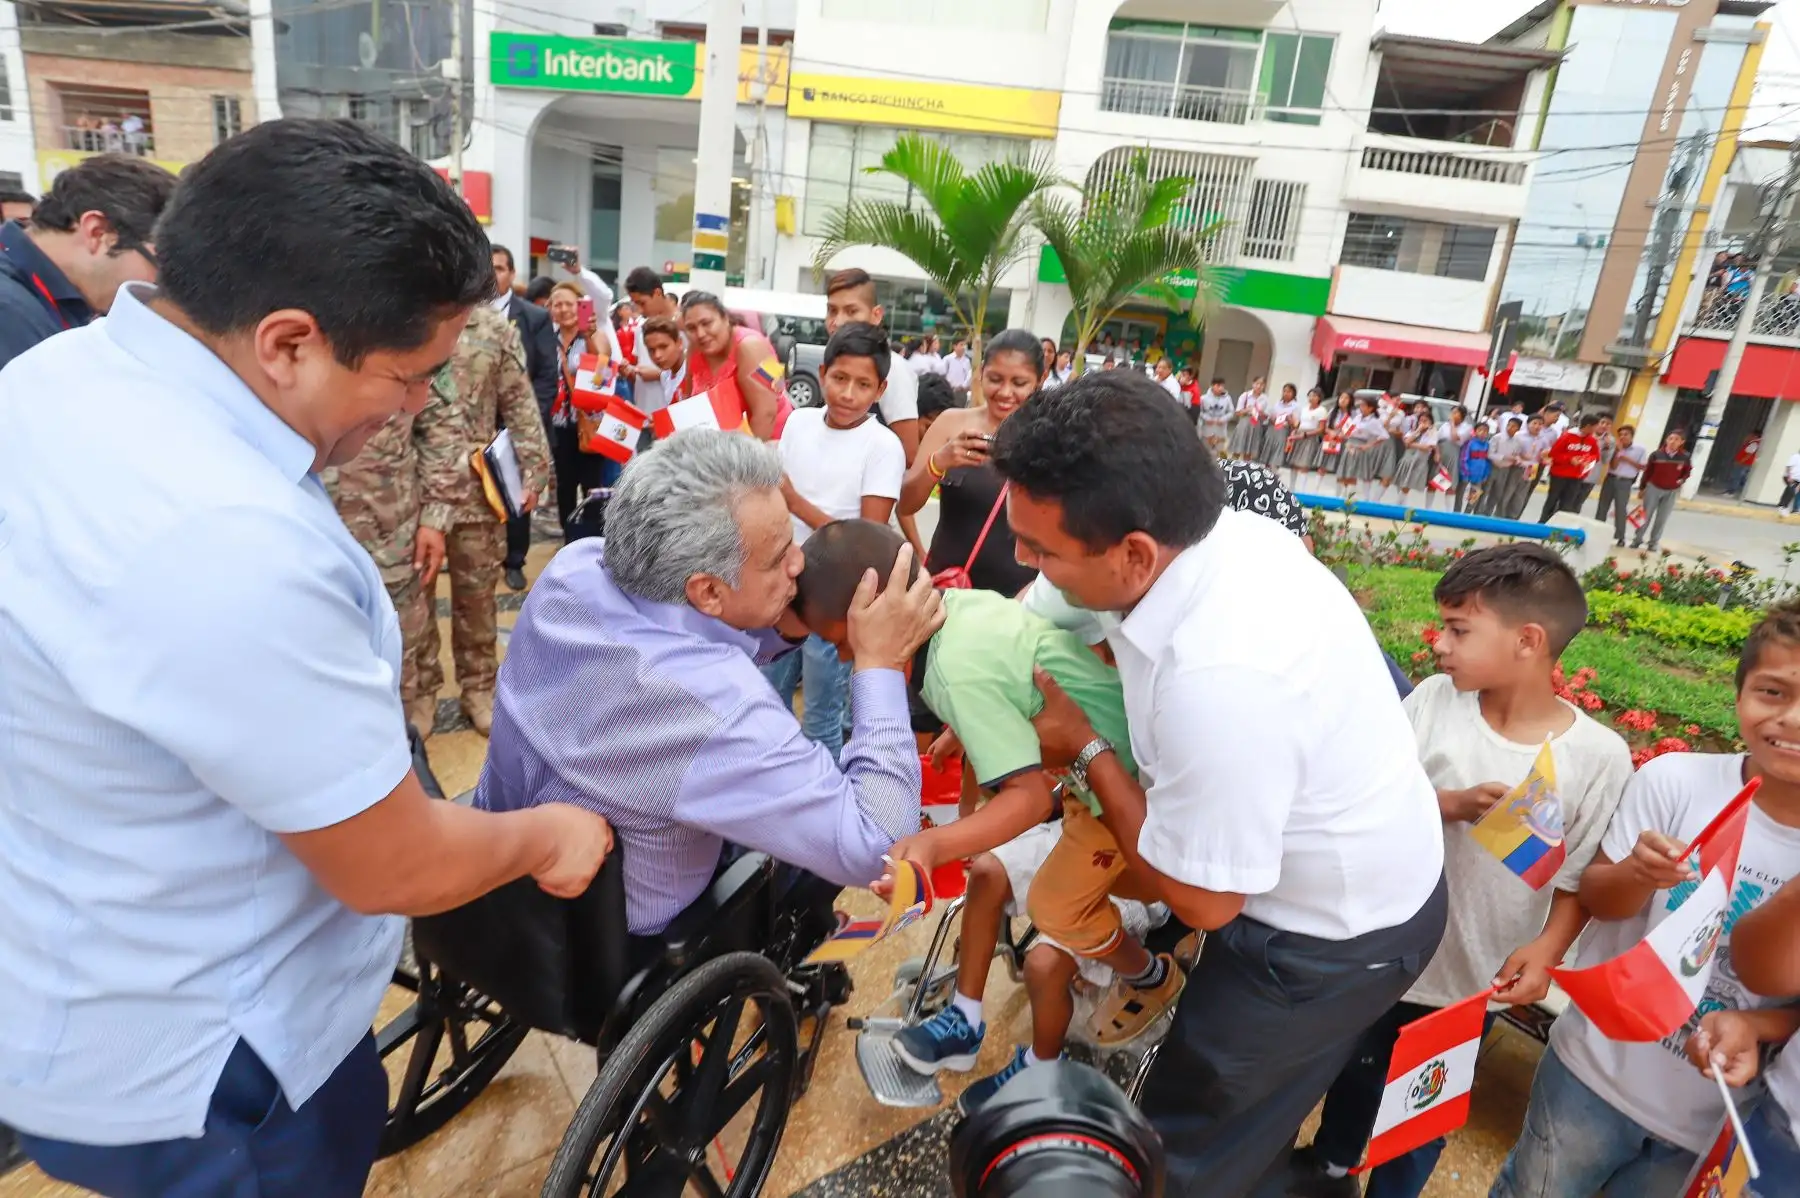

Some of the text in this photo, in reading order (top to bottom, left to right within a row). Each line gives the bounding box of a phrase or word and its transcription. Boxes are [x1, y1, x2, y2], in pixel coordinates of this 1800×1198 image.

[544, 48, 673, 83] Interbank
[821, 91, 945, 110] BANCO PICHINCHA
